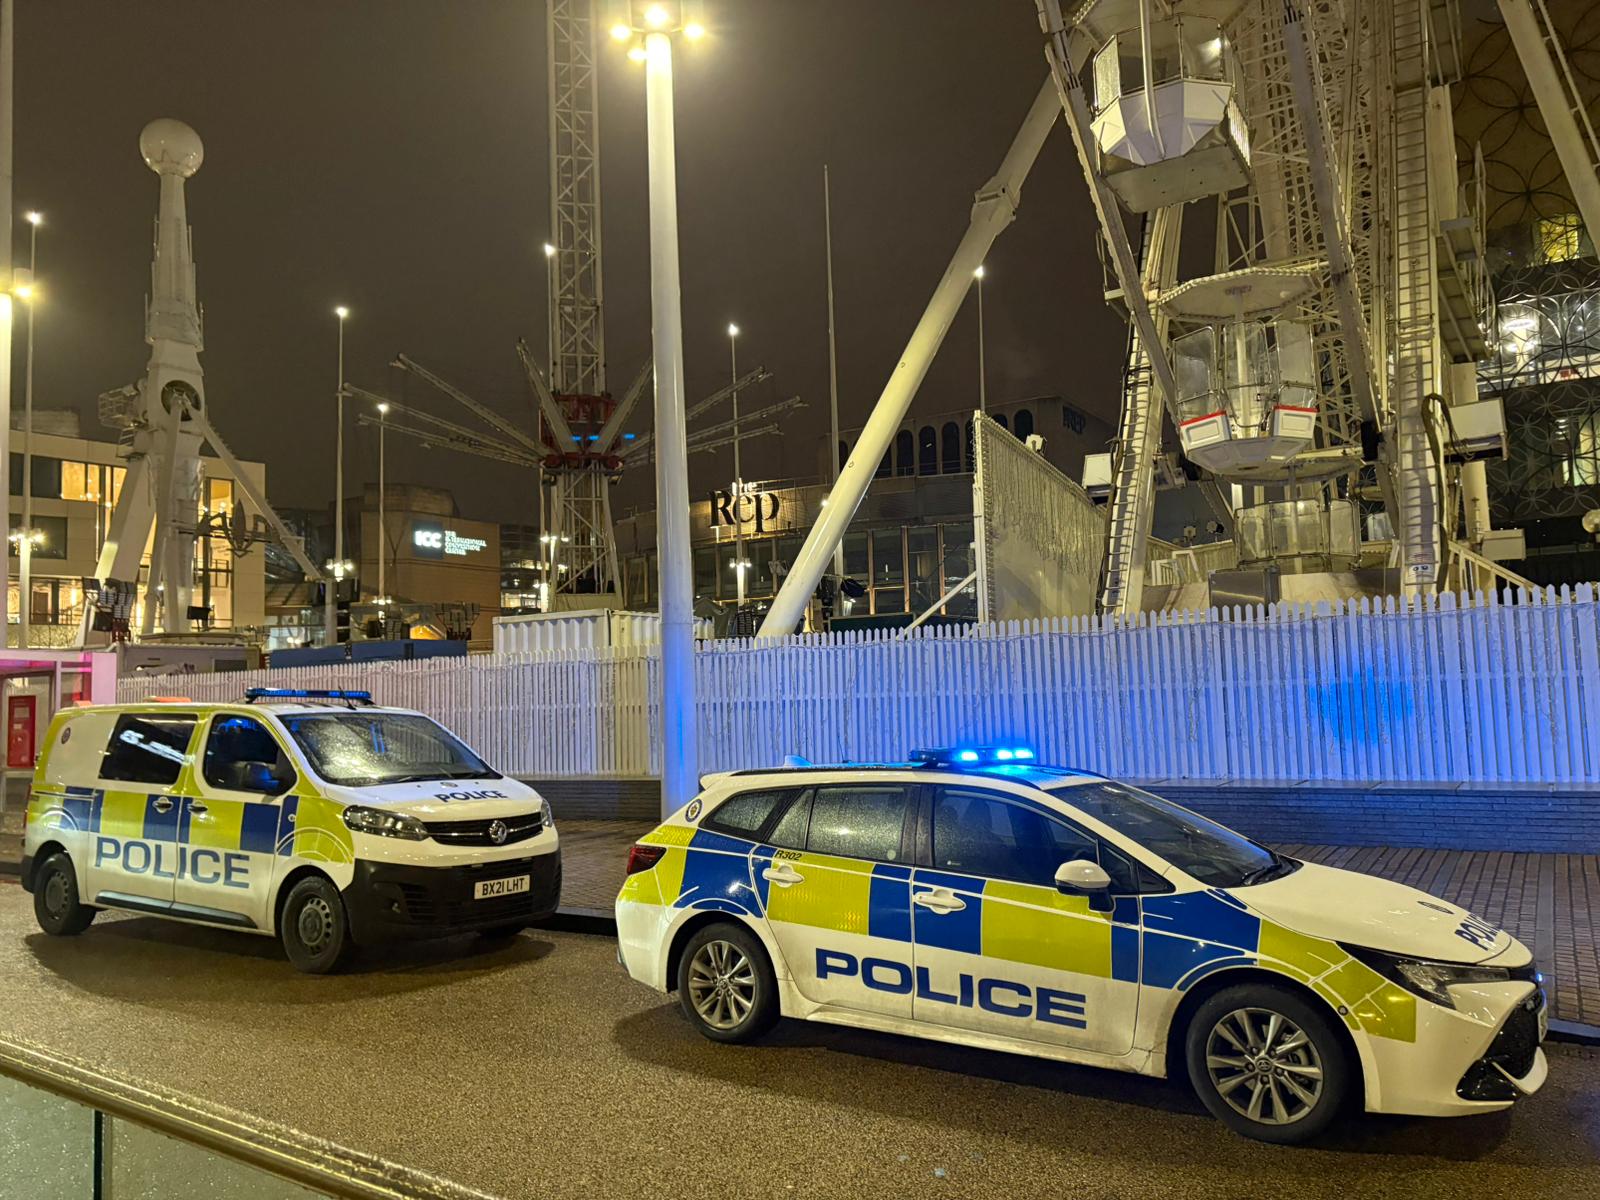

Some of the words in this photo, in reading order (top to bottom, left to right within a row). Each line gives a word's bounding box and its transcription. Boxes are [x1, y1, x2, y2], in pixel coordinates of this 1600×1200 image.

[708, 489, 780, 533] Rep
[415, 530, 442, 549] ICC
[434, 790, 508, 803] POLICE
[94, 836, 250, 889] POLICE
[774, 849, 802, 861] R302
[482, 880, 505, 896] BX21
[506, 877, 525, 894] LHT
[815, 947, 1087, 1030] POLICE
